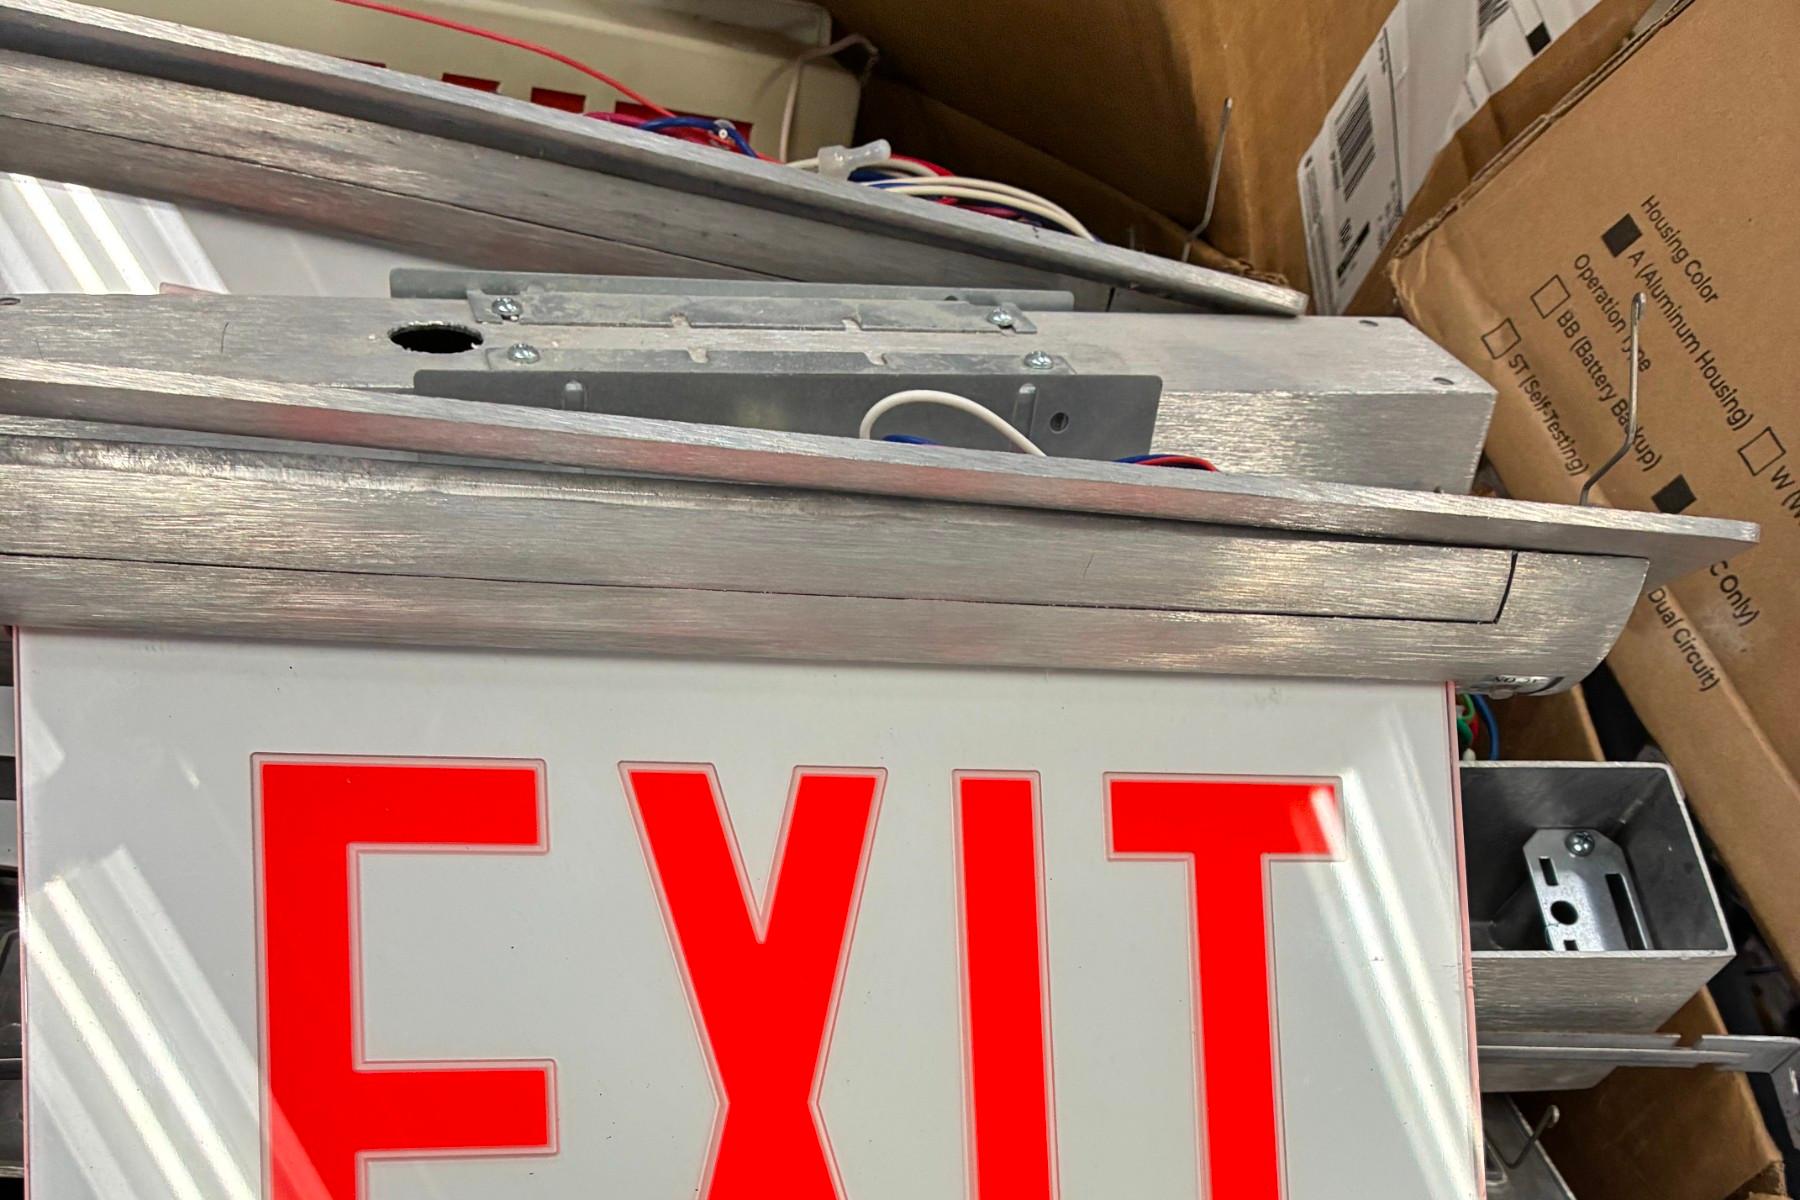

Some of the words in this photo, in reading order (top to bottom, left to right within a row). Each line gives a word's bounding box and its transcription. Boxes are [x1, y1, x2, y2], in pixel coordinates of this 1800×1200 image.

[1628, 250, 1646, 268] A
[1640, 195, 1689, 264] Housing
[1684, 259, 1719, 304] Color
[1574, 253, 1627, 334] Operation
[1634, 263, 1701, 355] (Aluminum
[1508, 353, 1530, 377] ST
[1556, 310, 1581, 339] BB
[1569, 335, 1617, 402] (Battery
[1695, 350, 1755, 431] Housing)
[1518, 375, 1590, 477] (Self-Testing)
[1771, 465, 1795, 490] W
[1647, 585, 1683, 629] Dual
[1672, 627, 1721, 692] Circuit)
[1720, 574, 1761, 627] Only)
